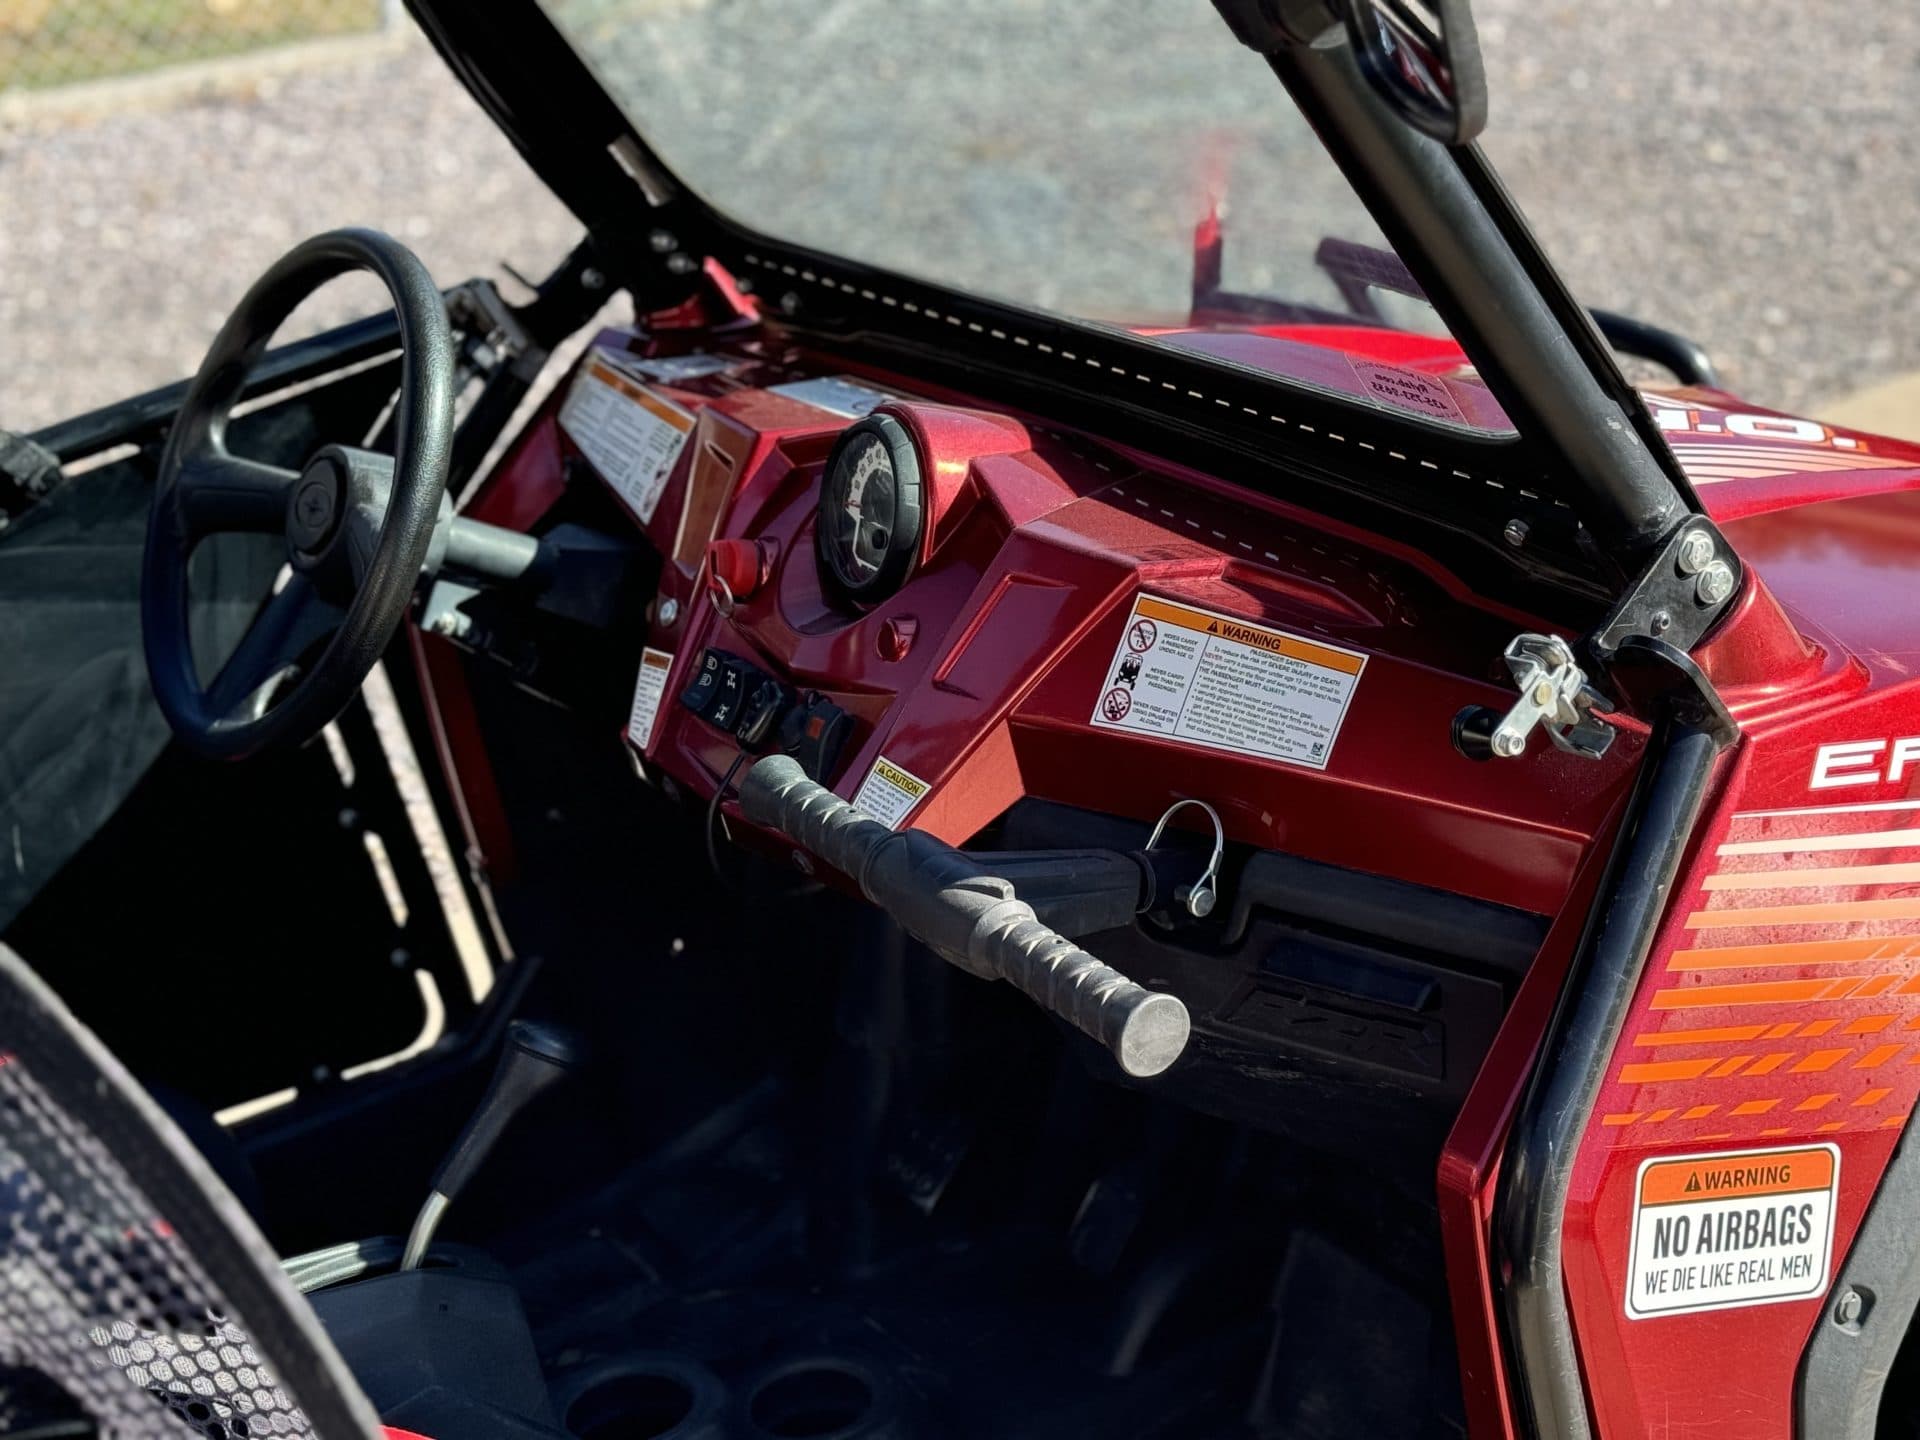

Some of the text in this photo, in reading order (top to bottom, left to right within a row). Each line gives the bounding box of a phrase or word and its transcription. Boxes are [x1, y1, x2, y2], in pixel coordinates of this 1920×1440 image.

[1221, 625, 1281, 649] WARNING
[885, 769, 920, 794] CAUTION
[1704, 1165, 1791, 1190] WARNING
[1653, 1204, 1813, 1259] NO AIRBAGS
[1646, 1254, 1813, 1295] WE DIE LIKE REAL MEN
